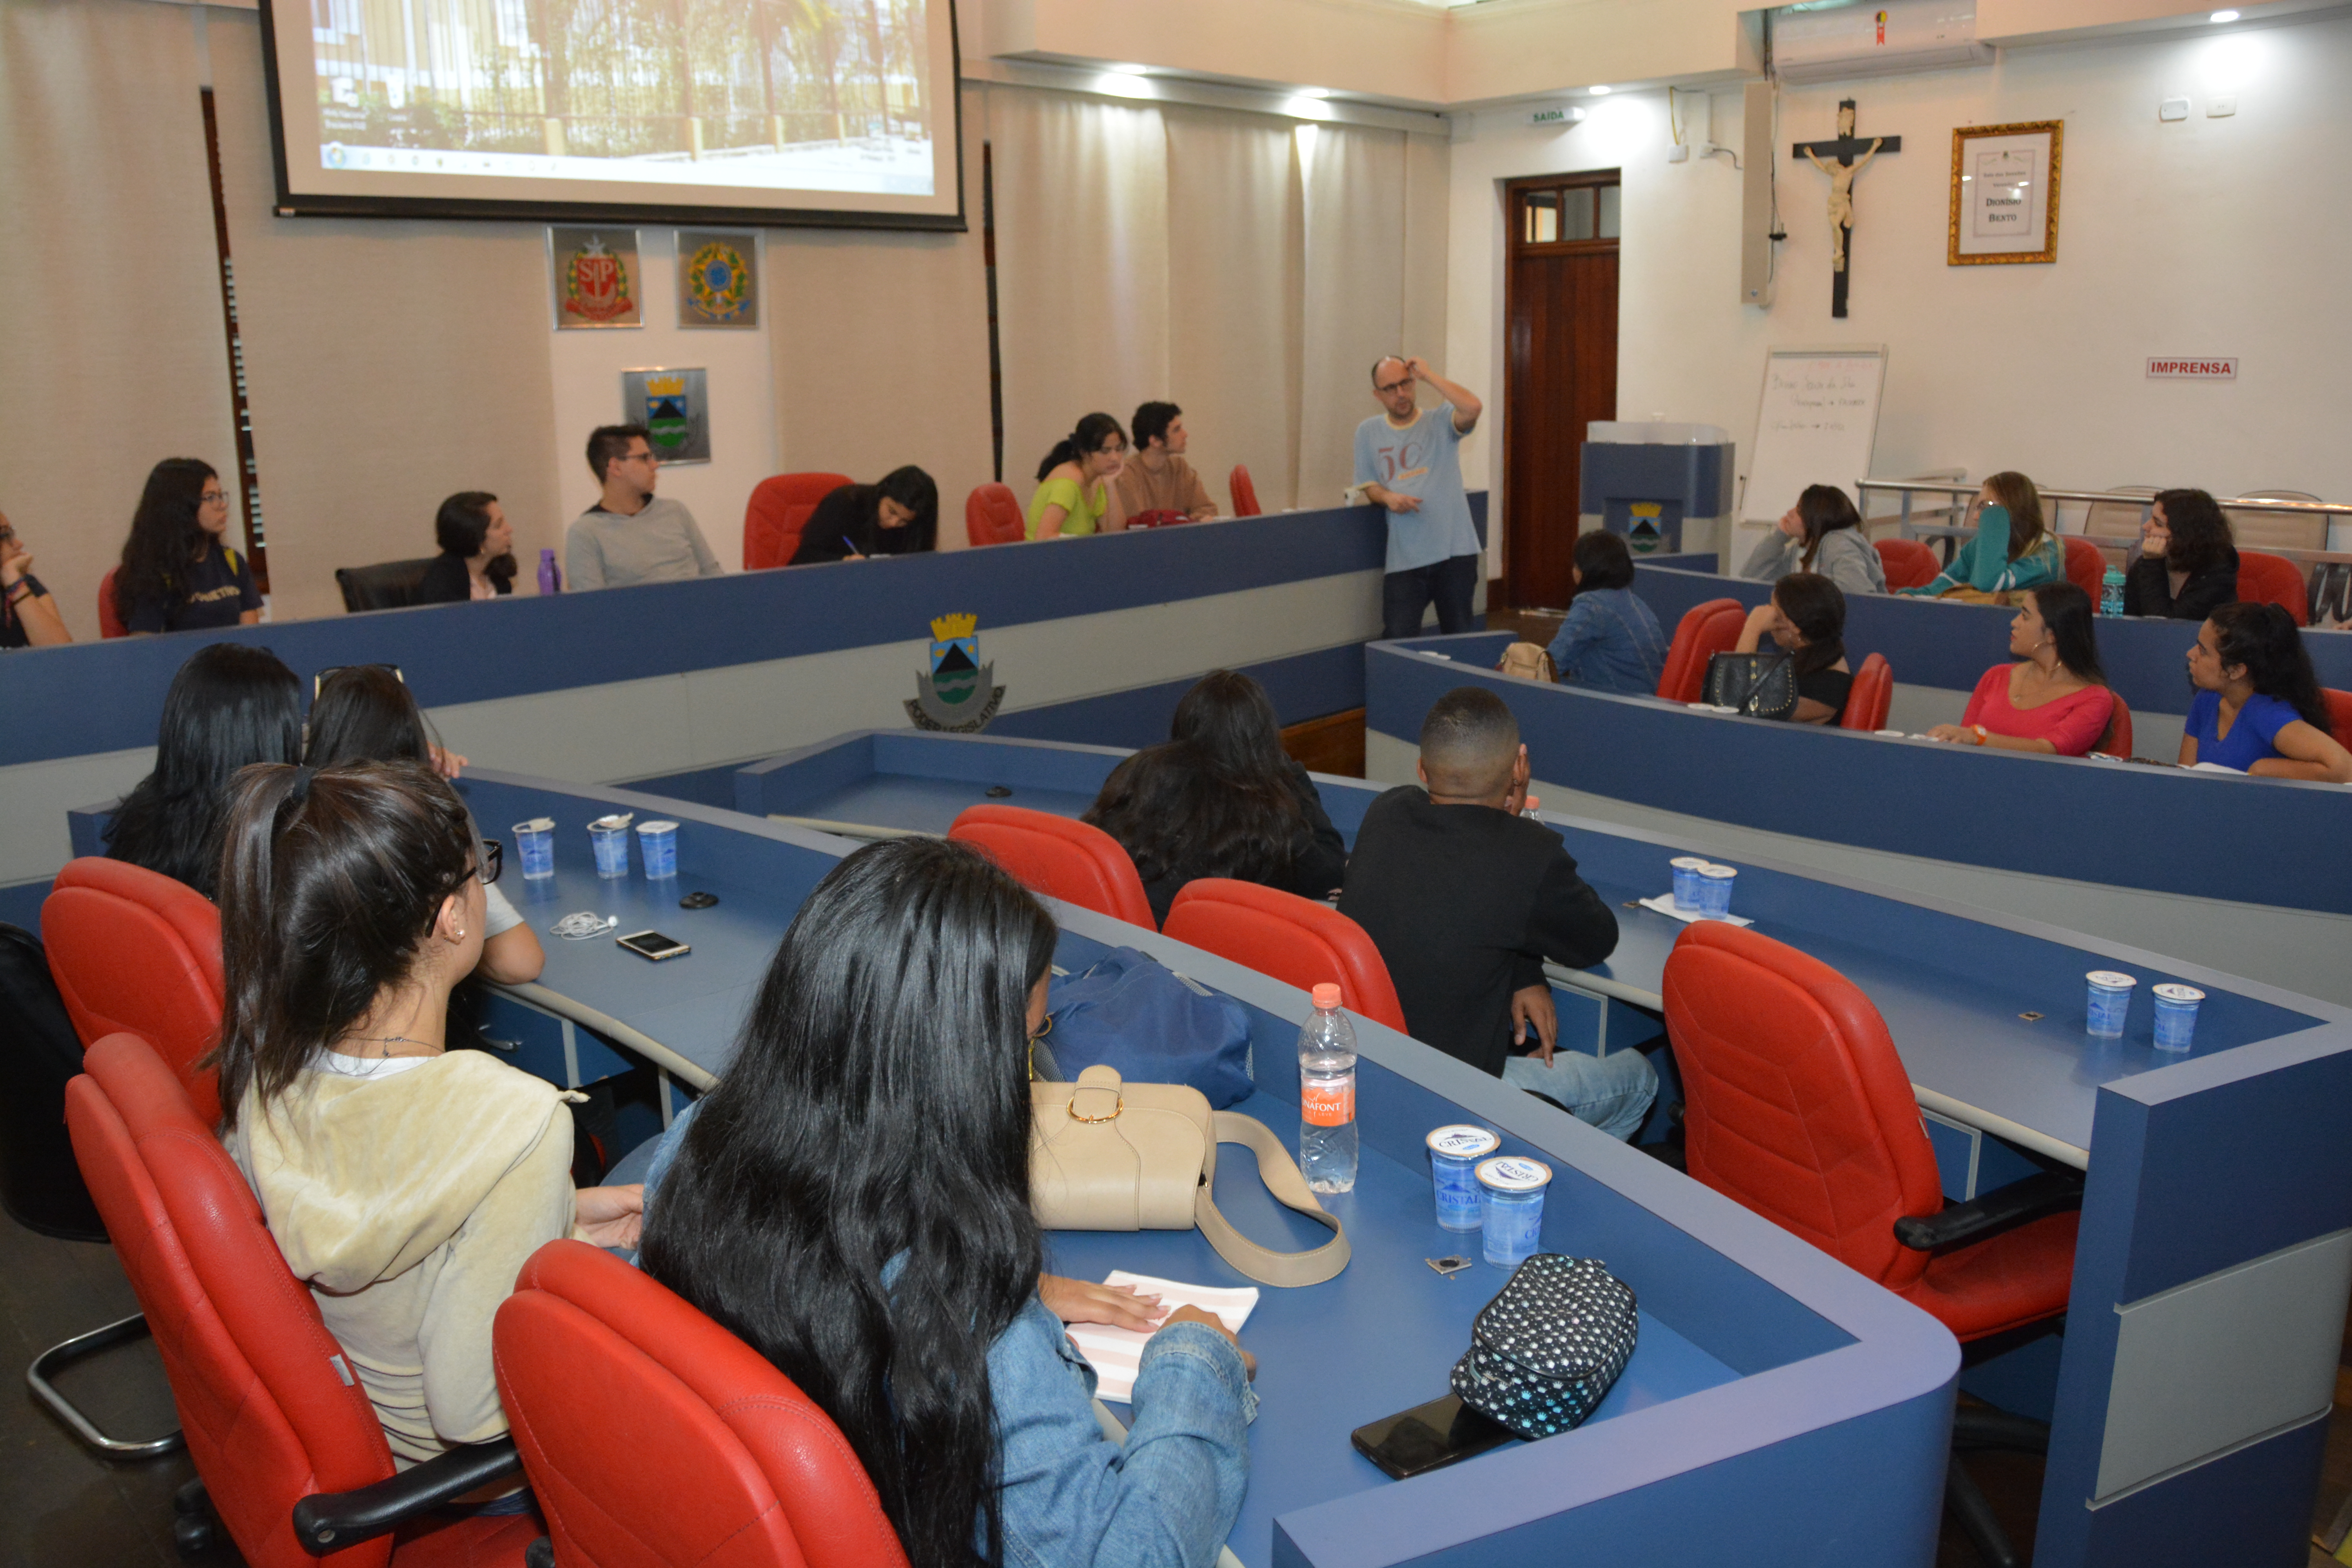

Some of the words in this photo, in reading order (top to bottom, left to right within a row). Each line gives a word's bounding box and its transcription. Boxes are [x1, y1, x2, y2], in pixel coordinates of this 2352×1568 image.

[2151, 362, 2231, 374] IMPRENSA
[1378, 441, 1423, 485] 50
[1301, 1098, 1341, 1112] ONAFONT
[1439, 1137, 1487, 1147] CRISTAL
[1436, 1190, 1481, 1205] CRISTAL
